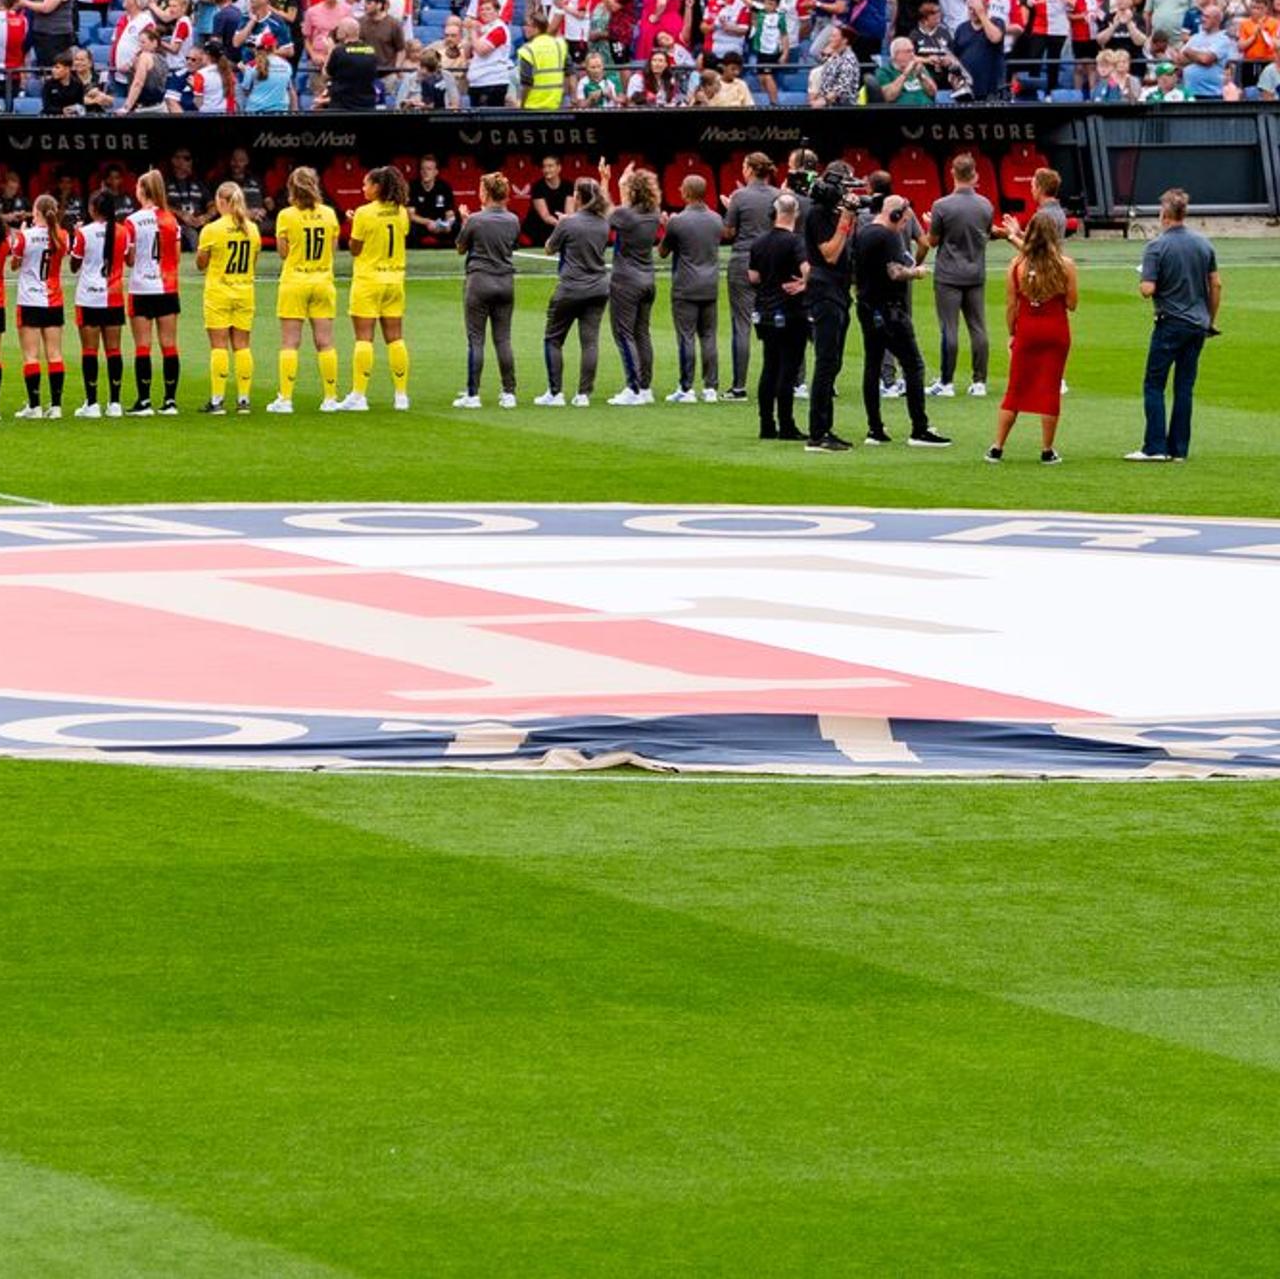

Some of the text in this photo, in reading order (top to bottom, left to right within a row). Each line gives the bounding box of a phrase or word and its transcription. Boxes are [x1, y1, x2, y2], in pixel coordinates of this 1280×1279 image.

[40, 133, 149, 150] CASTORE
[490, 127, 597, 145] CASTORE
[931, 122, 1036, 140] CASTORE
[302, 226, 325, 261] 16
[386, 223, 395, 259] 1
[225, 240, 251, 274] 20
